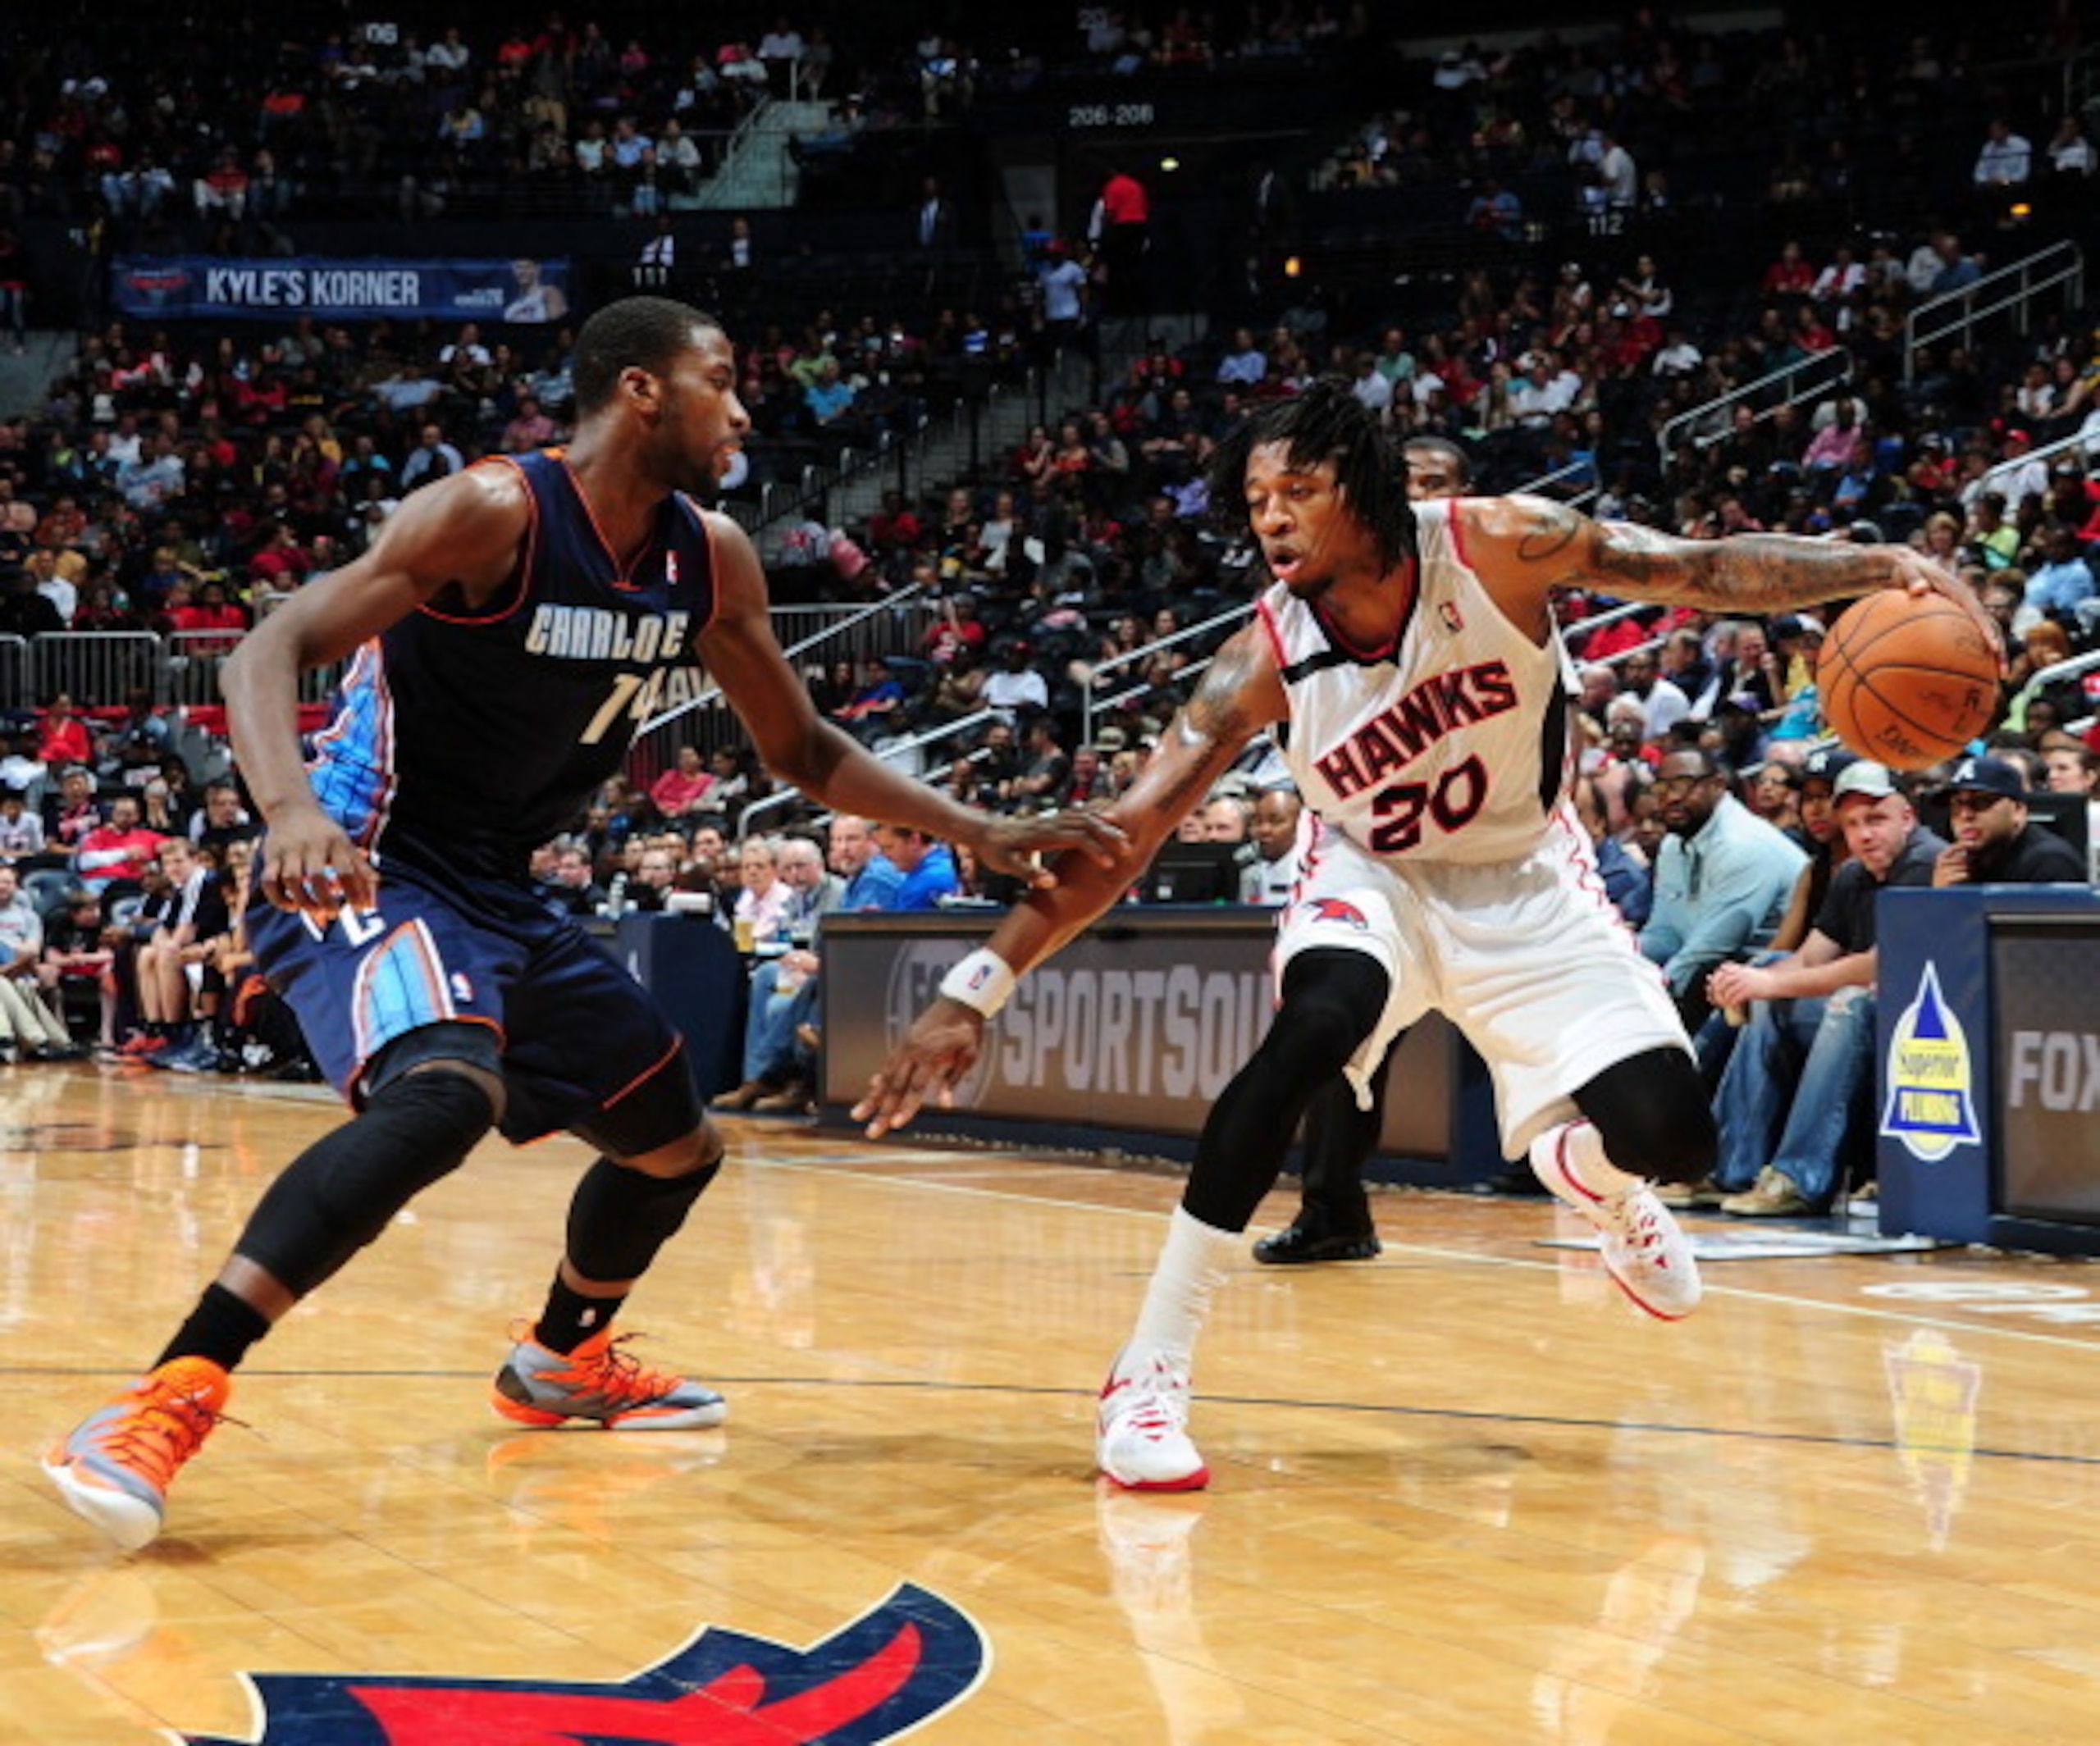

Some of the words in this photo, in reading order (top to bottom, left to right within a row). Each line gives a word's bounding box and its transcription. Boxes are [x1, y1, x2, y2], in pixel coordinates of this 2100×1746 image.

[1588, 213, 1623, 236] 112
[207, 269, 304, 306] KYLE'S
[313, 271, 419, 307] KORNER
[1312, 659, 1520, 801] HAWKS
[1372, 753, 1488, 853] 20
